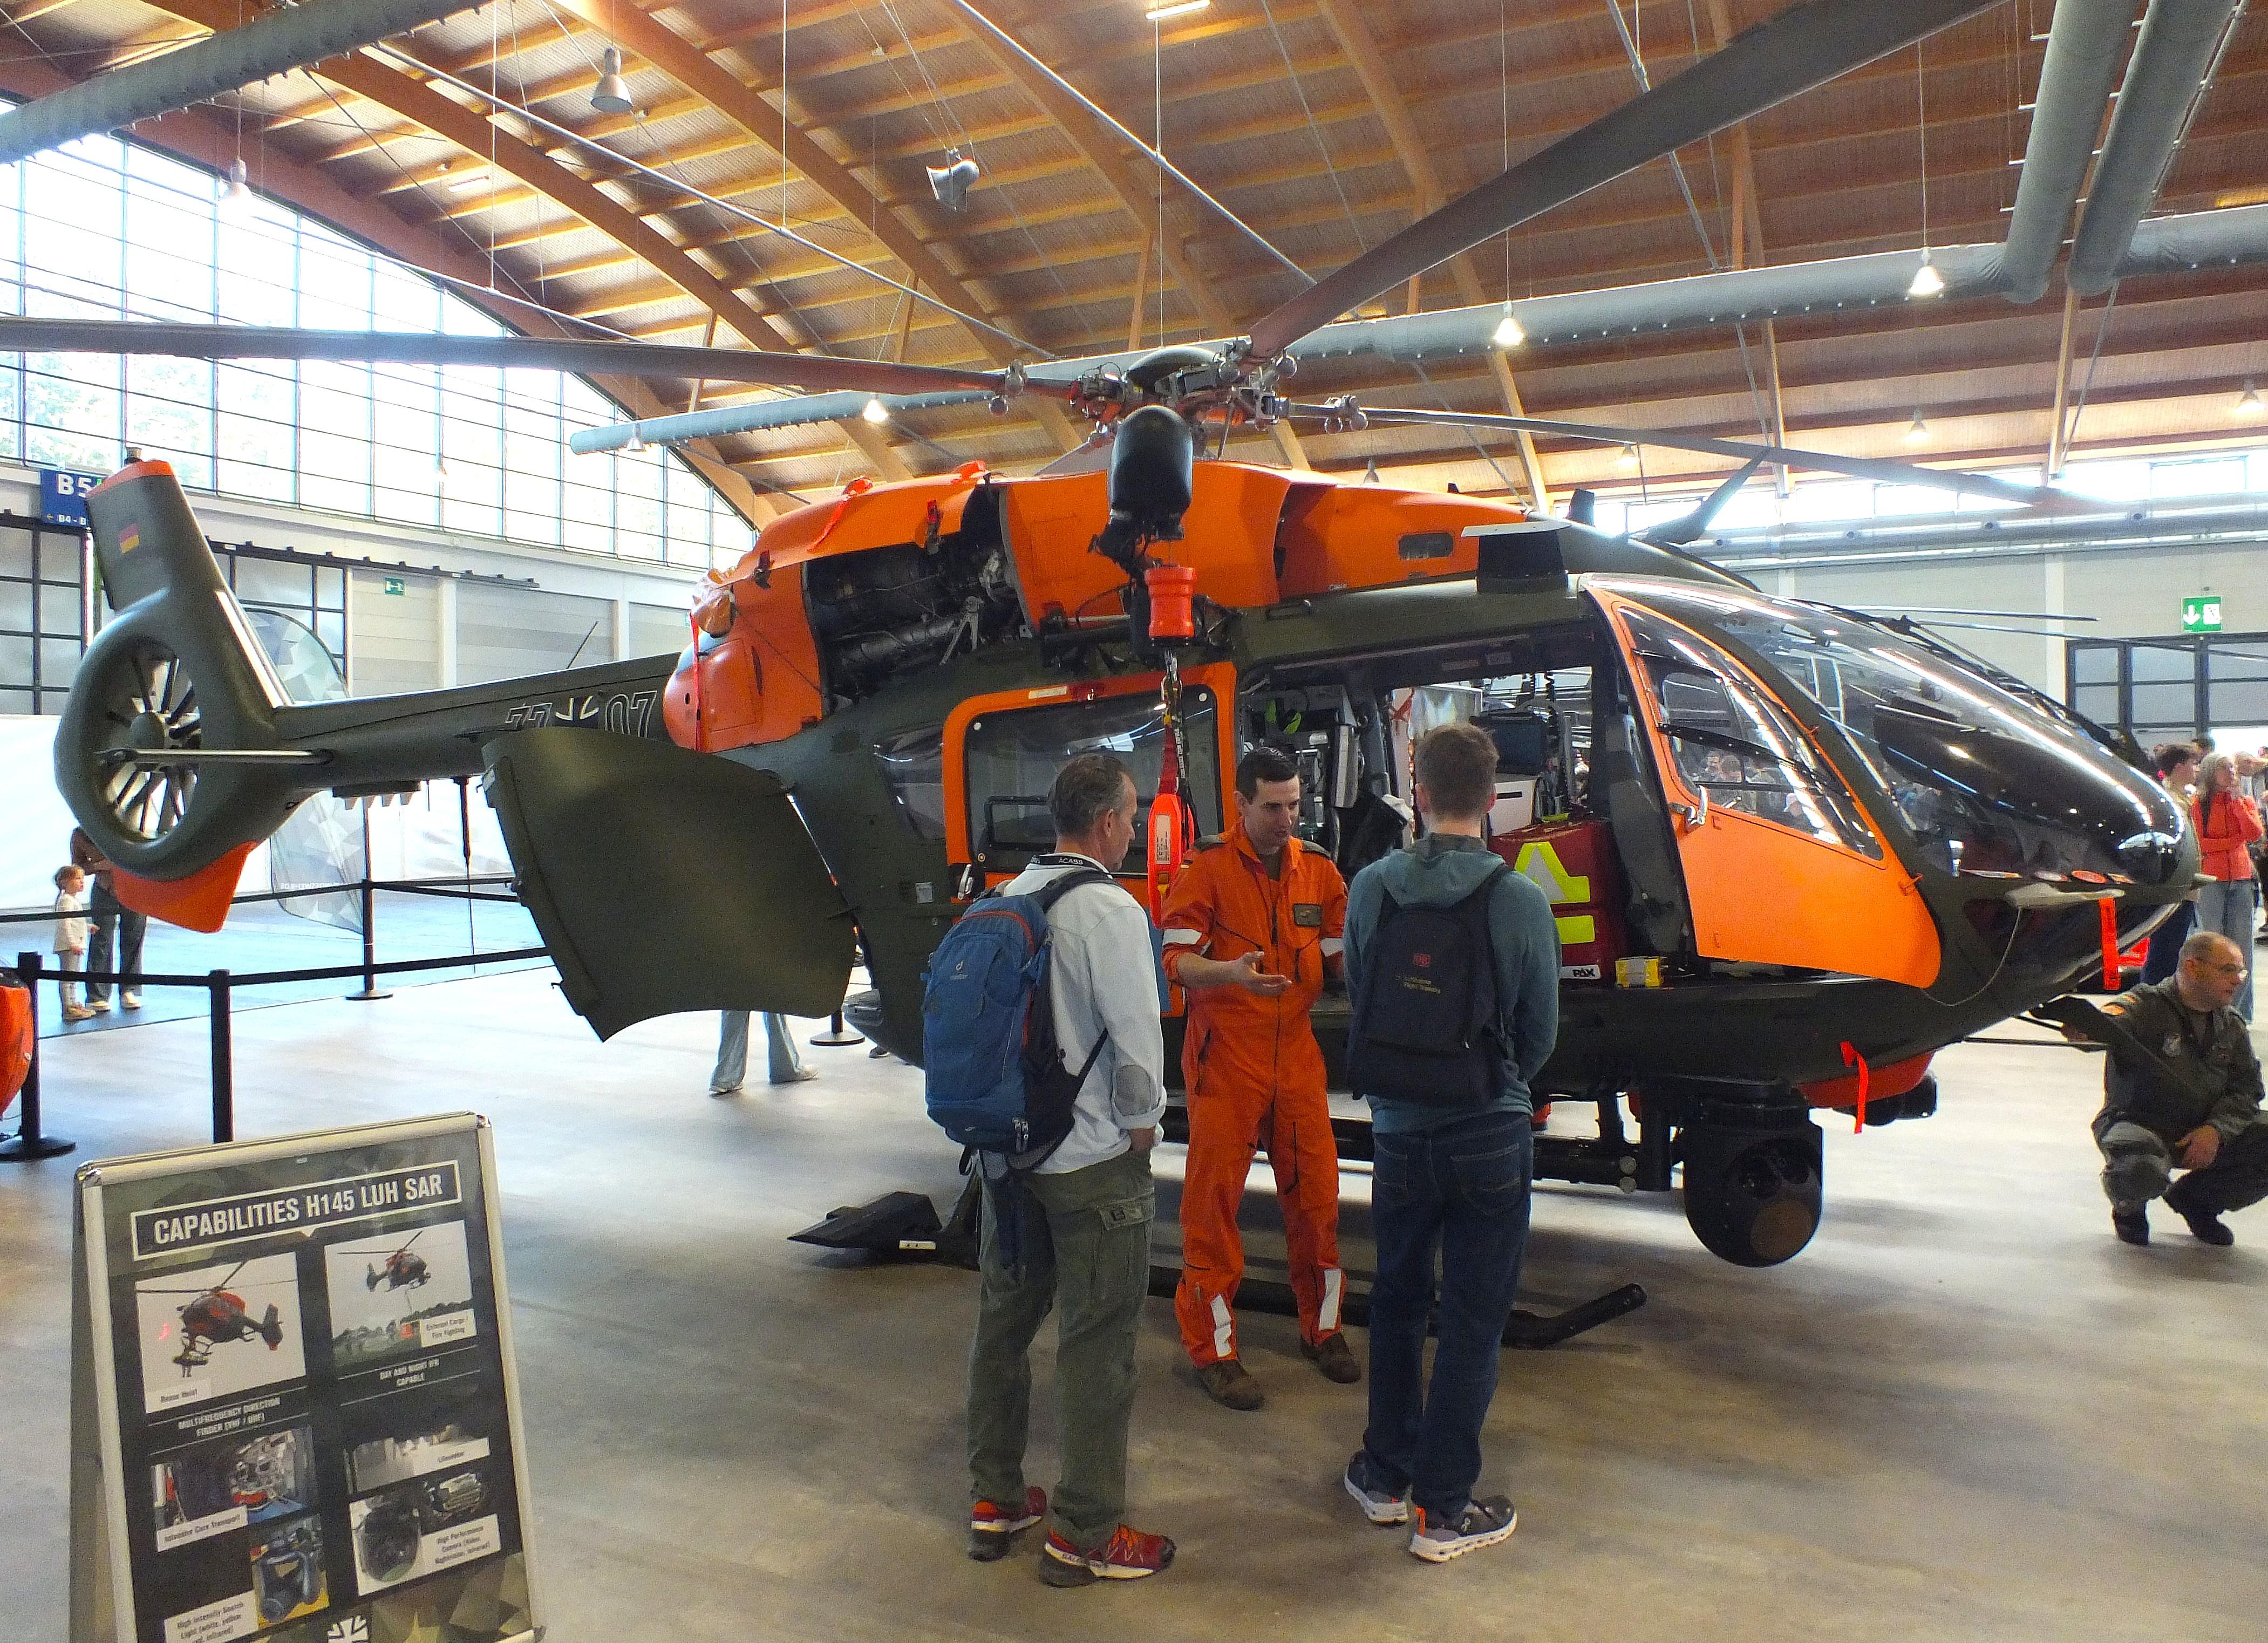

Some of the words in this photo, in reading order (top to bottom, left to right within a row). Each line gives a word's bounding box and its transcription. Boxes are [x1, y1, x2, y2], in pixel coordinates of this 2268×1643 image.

[57, 473, 96, 497] B5
[58, 514, 71, 523] B4
[79, 517, 87, 526] B
[504, 703, 553, 728] 77
[605, 690, 657, 739] 07
[1058, 856, 1084, 865] ACASS
[1572, 968, 1596, 977] PAX
[153, 1198, 299, 1244] CAPABILITIES
[306, 1189, 356, 1217] H145
[361, 1180, 399, 1208] LUH
[405, 1174, 444, 1201] SAR
[379, 1371, 392, 1380] DAY
[393, 1366, 407, 1376] AND
[408, 1361, 427, 1373] NIGHT
[396, 1372, 425, 1386] CAPABLE
[178, 1407, 242, 1430] MULTIFREQUENCY
[242, 1397, 280, 1414] DIRECTION
[196, 1423, 223, 1437] FINDER
